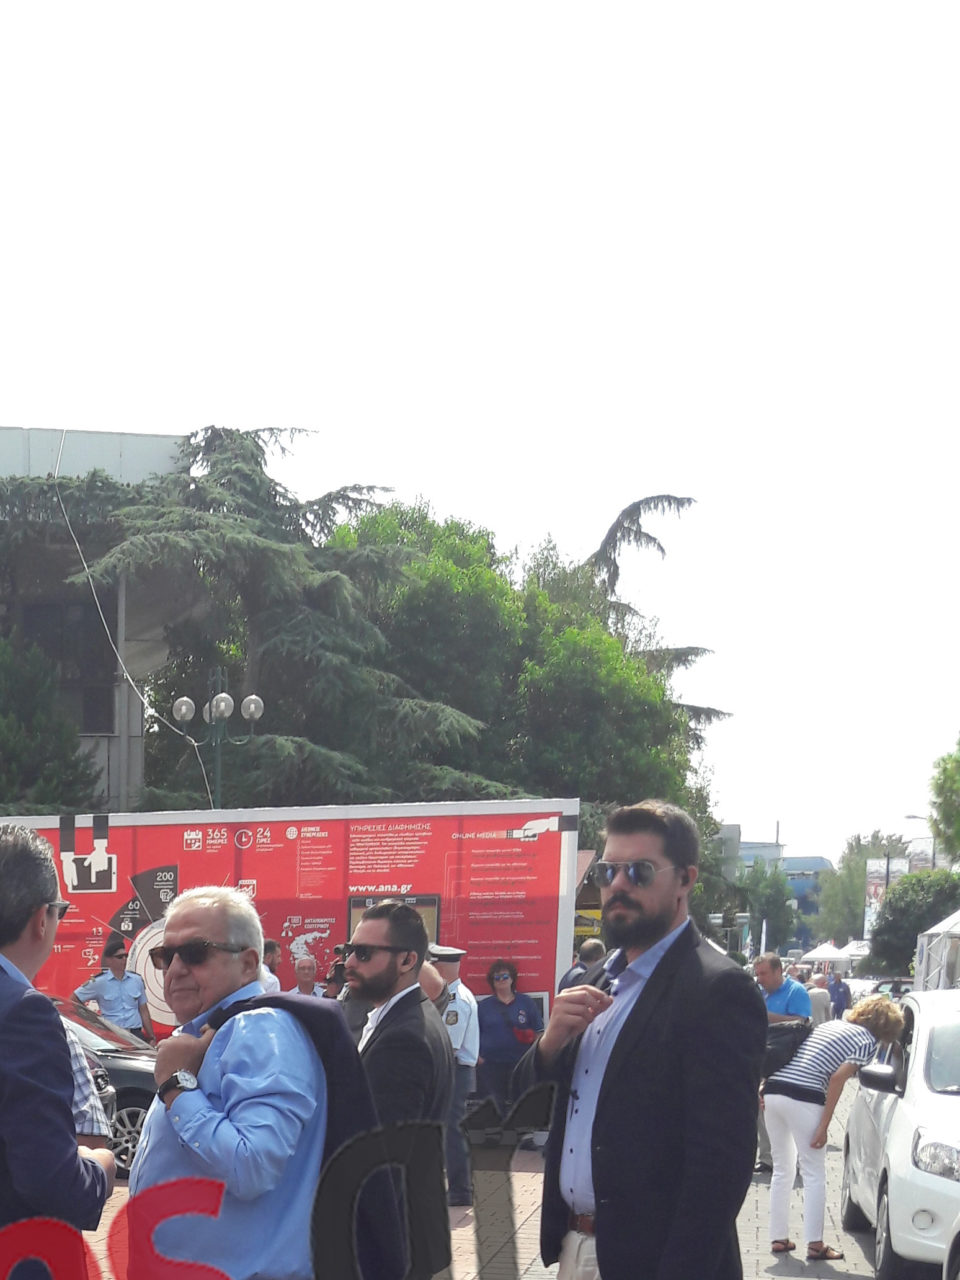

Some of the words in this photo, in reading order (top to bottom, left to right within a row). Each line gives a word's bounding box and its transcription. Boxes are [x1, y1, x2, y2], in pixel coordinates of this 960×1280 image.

[206, 828, 228, 839] 365
[256, 827, 271, 838] 24
[476, 831, 497, 839] MEDIA
[156, 872, 174, 881] 200
[348, 884, 413, 894] www.ana.gr
[128, 900, 140, 910] 60
[92, 927, 103, 936] 13
